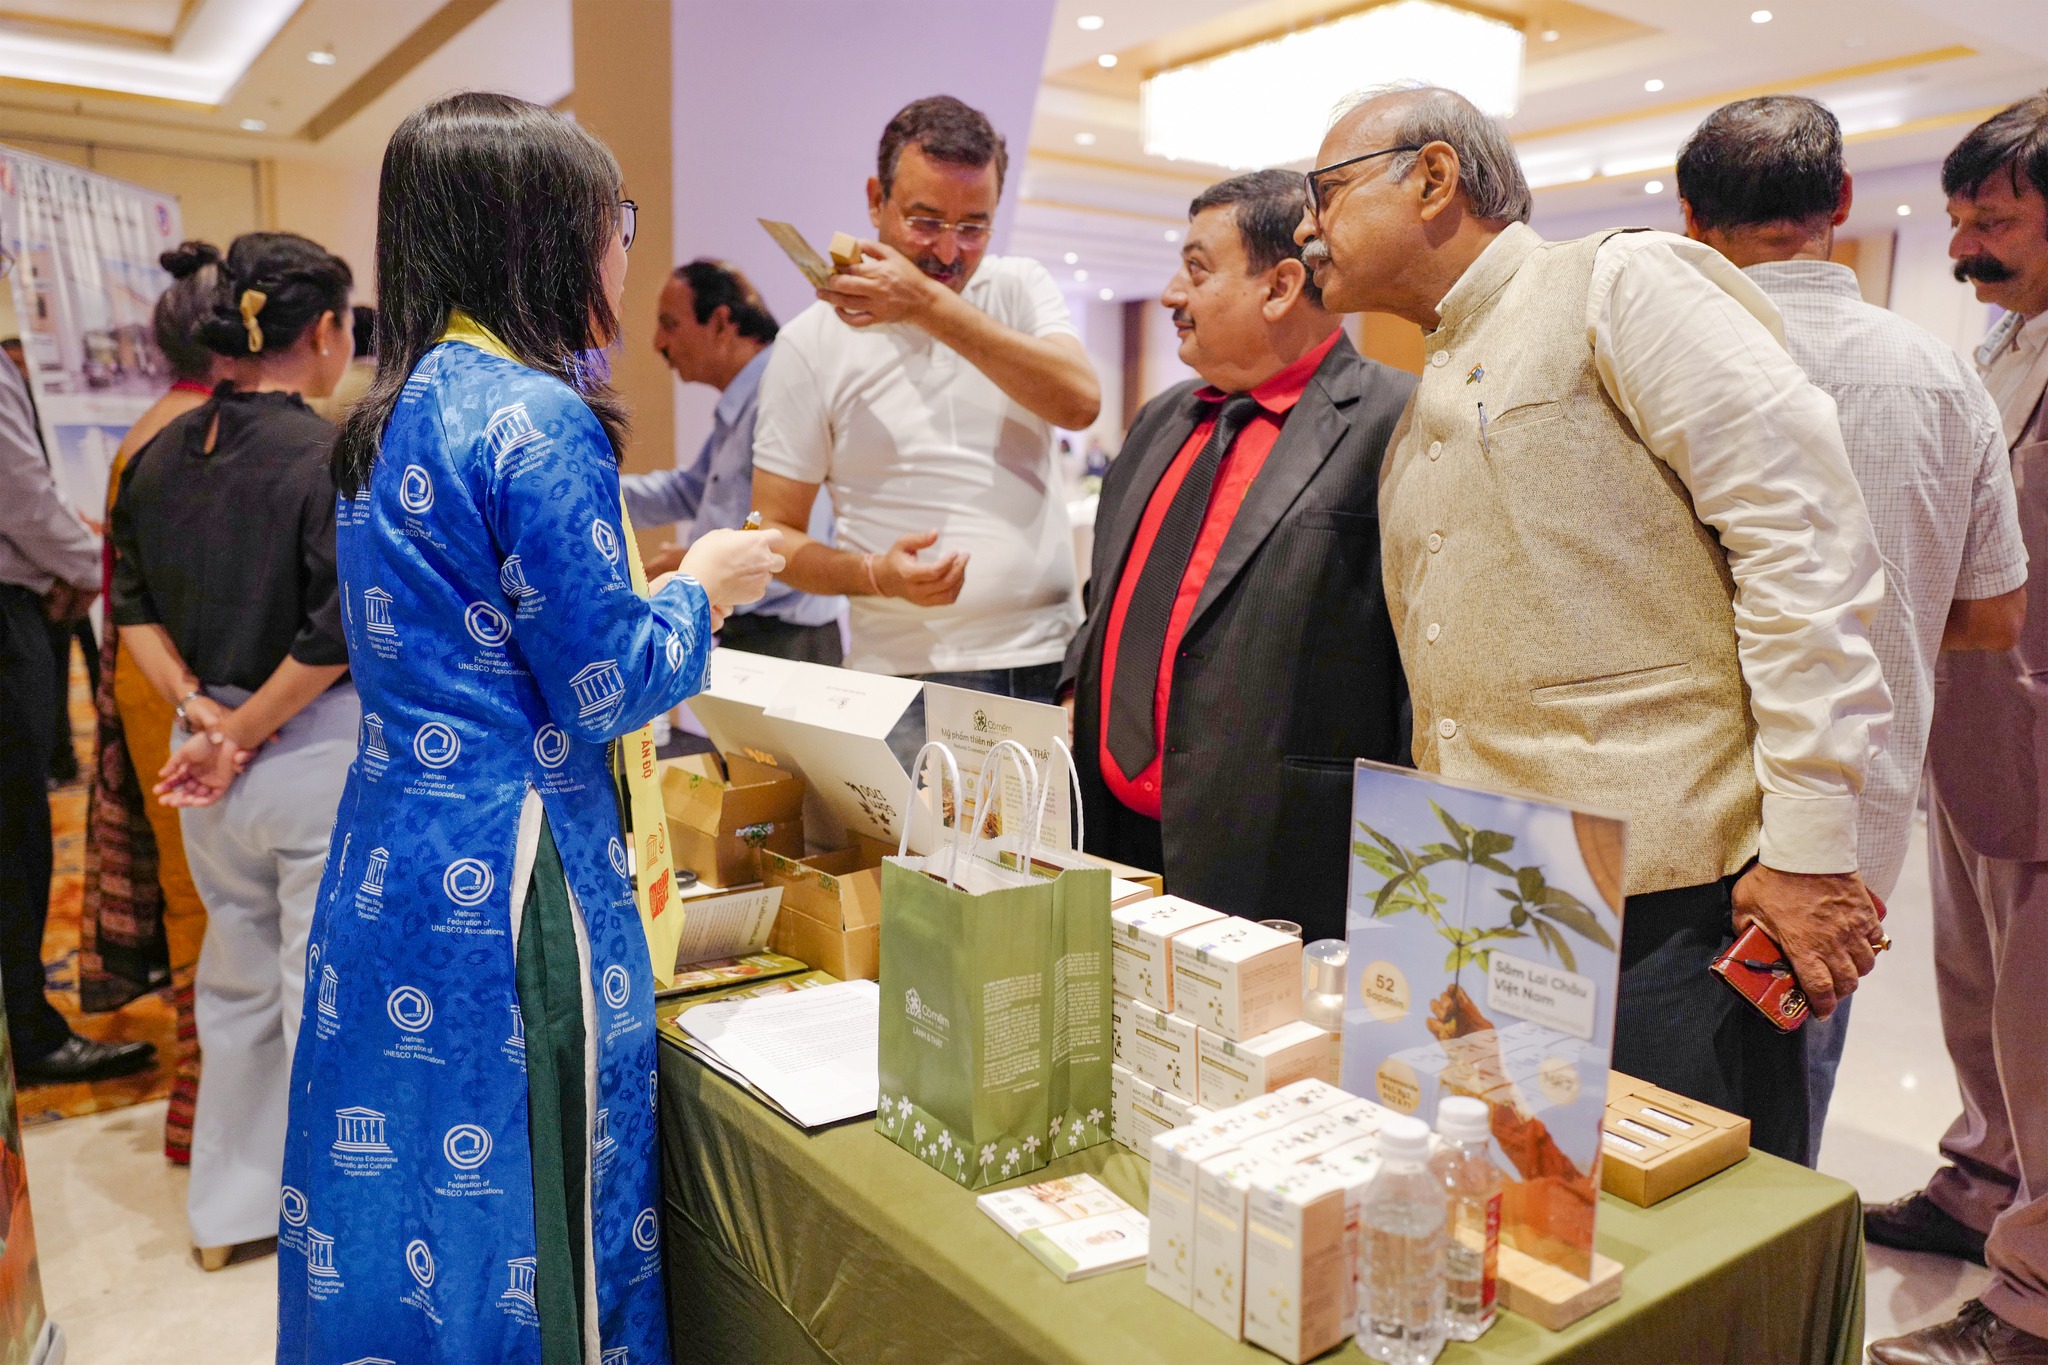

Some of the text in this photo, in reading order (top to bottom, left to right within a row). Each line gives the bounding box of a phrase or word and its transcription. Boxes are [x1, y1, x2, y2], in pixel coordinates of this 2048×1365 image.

[509, 460, 543, 479] Organization
[600, 581, 626, 594] UNESCO
[365, 599, 392, 624] UNESC
[479, 650, 505, 659] Vietnam
[474, 656, 508, 667] Federation
[458, 663, 531, 677] UNESCO Associations
[574, 667, 624, 707] UNESCO
[941, 728, 951, 740] Mỹ
[969, 734, 986, 745] thiên
[642, 760, 654, 779] ĐỘ
[422, 772, 447, 781] Vietnam
[544, 772, 565, 780] Vietnam
[414, 780, 454, 790] Federation of
[542, 778, 568, 788] Federation
[404, 788, 466, 800] NESCO Associations
[453, 909, 480, 917] Vietnam
[447, 918, 483, 926] Federation
[431, 925, 504, 936] UNESCO Associations
[1375, 974, 1394, 992] 52
[1495, 960, 1588, 999] Sâm Lai Châu
[1494, 978, 1555, 1007] Việt Nam
[1366, 988, 1404, 1009] Saponin
[613, 1011, 629, 1021] Vietnam
[401, 1035, 425, 1044] Vietnam
[395, 1043, 433, 1054] Federation of
[500, 1046, 518, 1056] United
[383, 1050, 446, 1065] UNESCO Associations
[338, 1117, 385, 1143] UNESCO
[343, 1154, 364, 1162] Nations
[365, 1155, 398, 1163] Educational
[333, 1160, 356, 1169] Scientific
[369, 1162, 392, 1170] Cultural
[344, 1169, 380, 1178] Organization
[454, 1173, 480, 1181] Vietnam
[447, 1179, 490, 1189] Federation of
[464, 1187, 504, 1196] Associations
[629, 1270, 653, 1286] UNESCO
[315, 1279, 344, 1288] Educational
[318, 1286, 339, 1294] Cultural
[496, 1300, 513, 1308] United
[503, 1308, 525, 1318] Scientific
